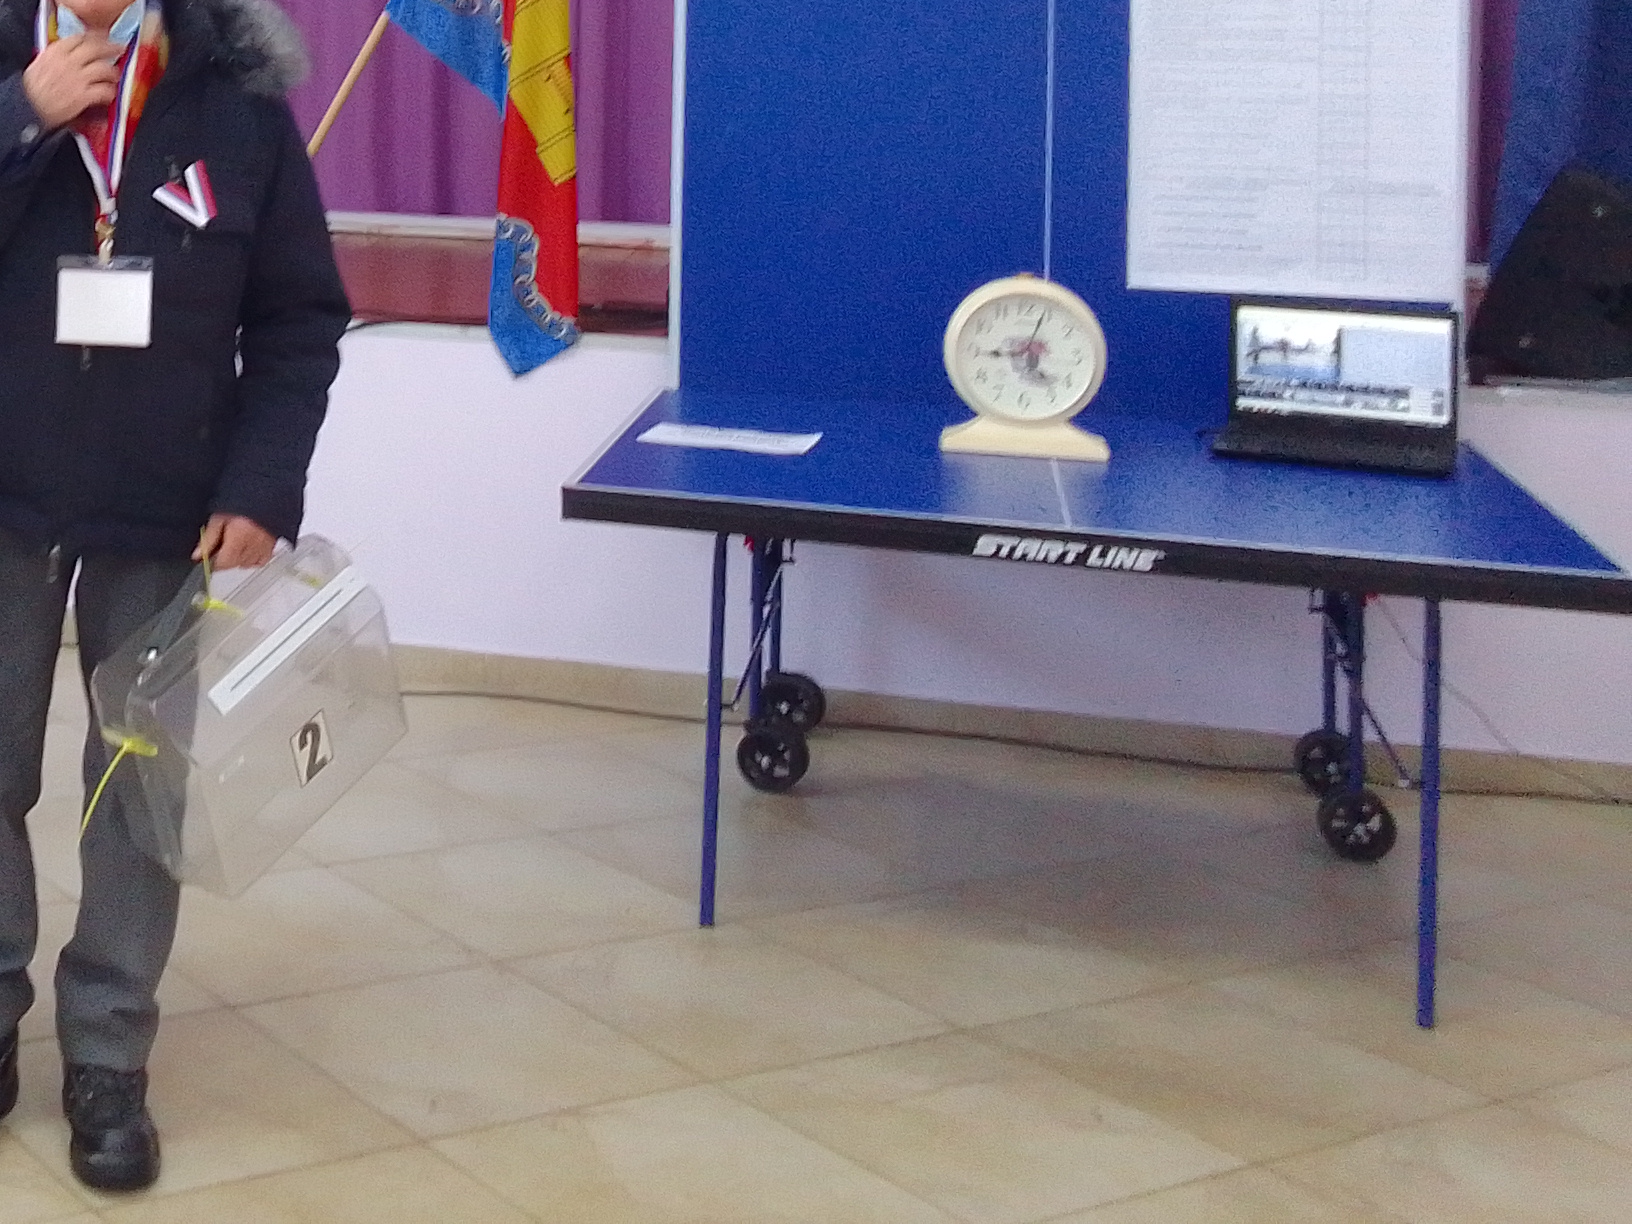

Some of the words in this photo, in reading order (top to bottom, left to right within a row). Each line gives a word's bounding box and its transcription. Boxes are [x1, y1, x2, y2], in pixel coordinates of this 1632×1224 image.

[972, 533, 1088, 565] START
[1086, 543, 1161, 572] LINE
[298, 721, 328, 784] 2
